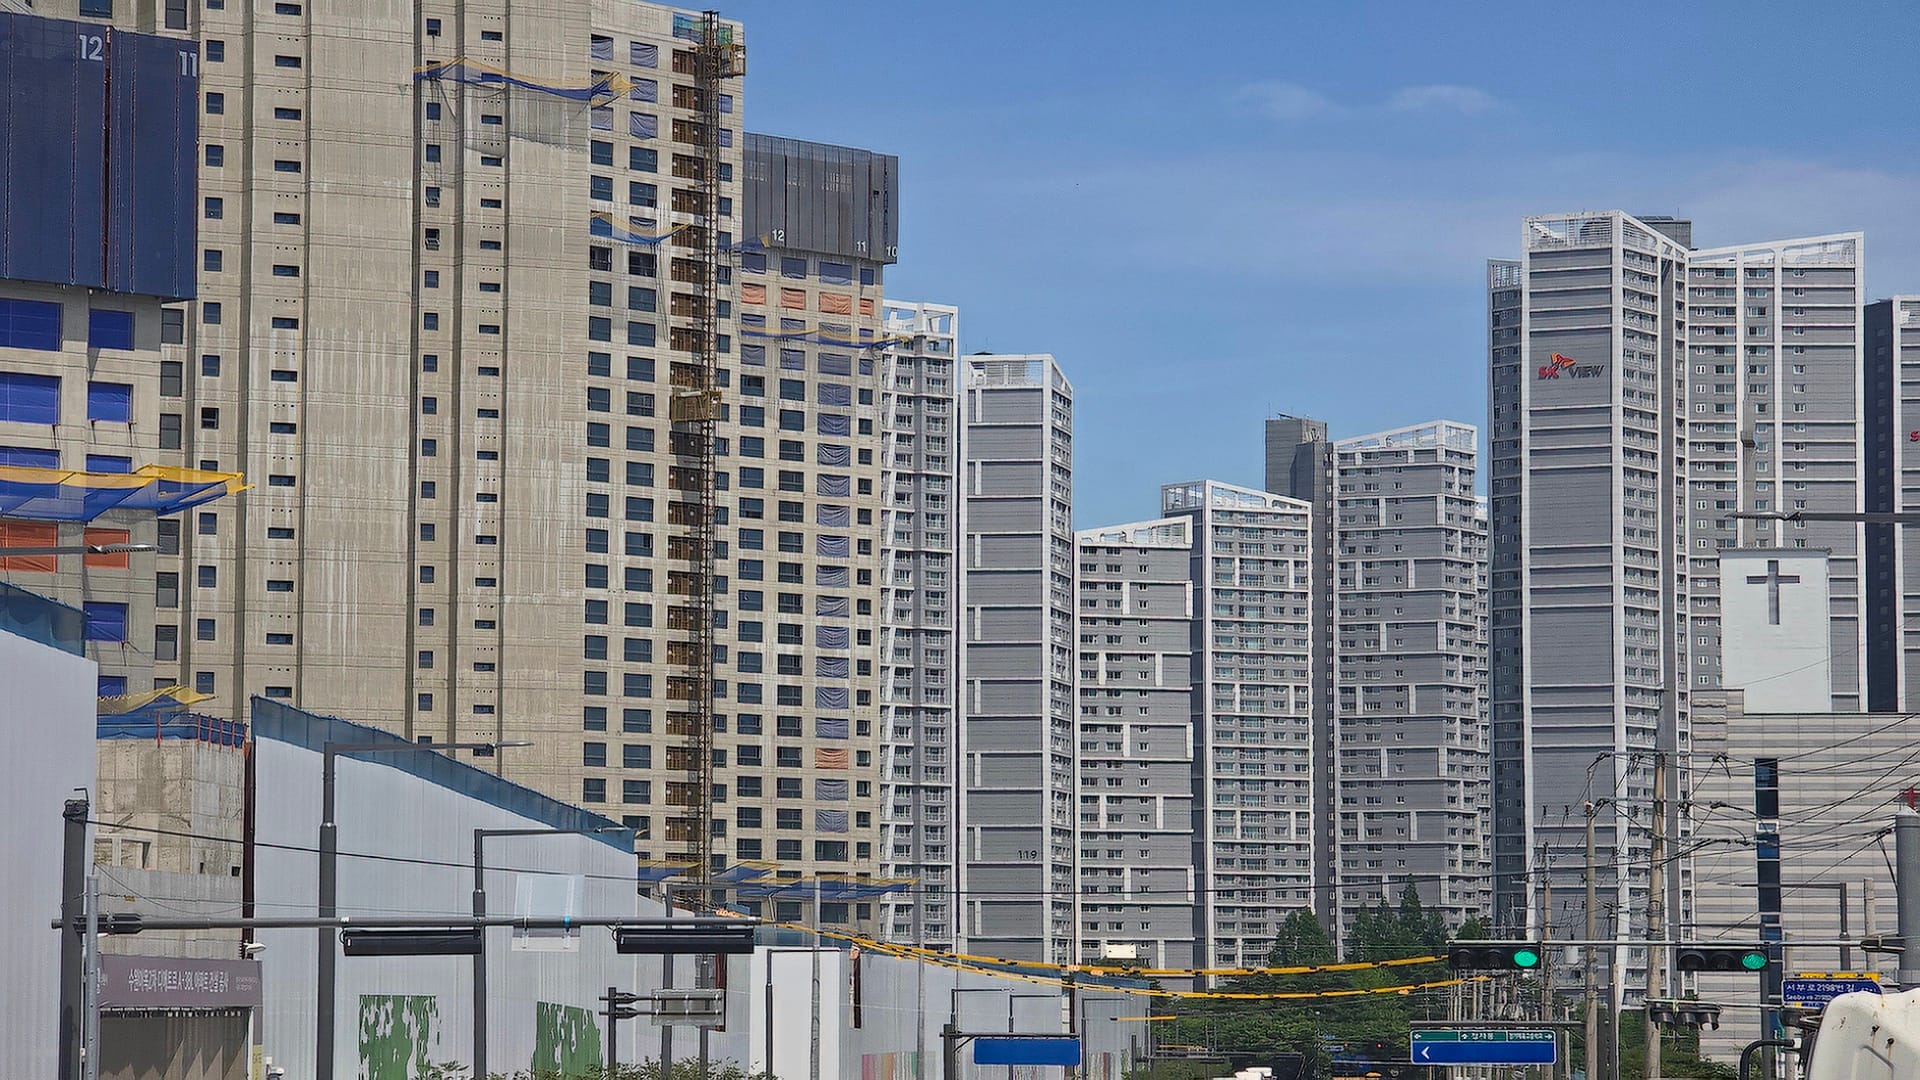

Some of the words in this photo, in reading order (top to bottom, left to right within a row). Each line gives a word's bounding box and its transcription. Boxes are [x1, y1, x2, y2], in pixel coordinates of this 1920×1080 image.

[79, 34, 103, 61] 12
[179, 50, 198, 77] 11
[772, 228, 785, 242] 12
[857, 240, 867, 252] 11
[886, 245, 898, 257] 10
[1538, 365, 1560, 380] SK
[1568, 365, 1605, 379] VIEW
[1017, 849, 1038, 860] 119
